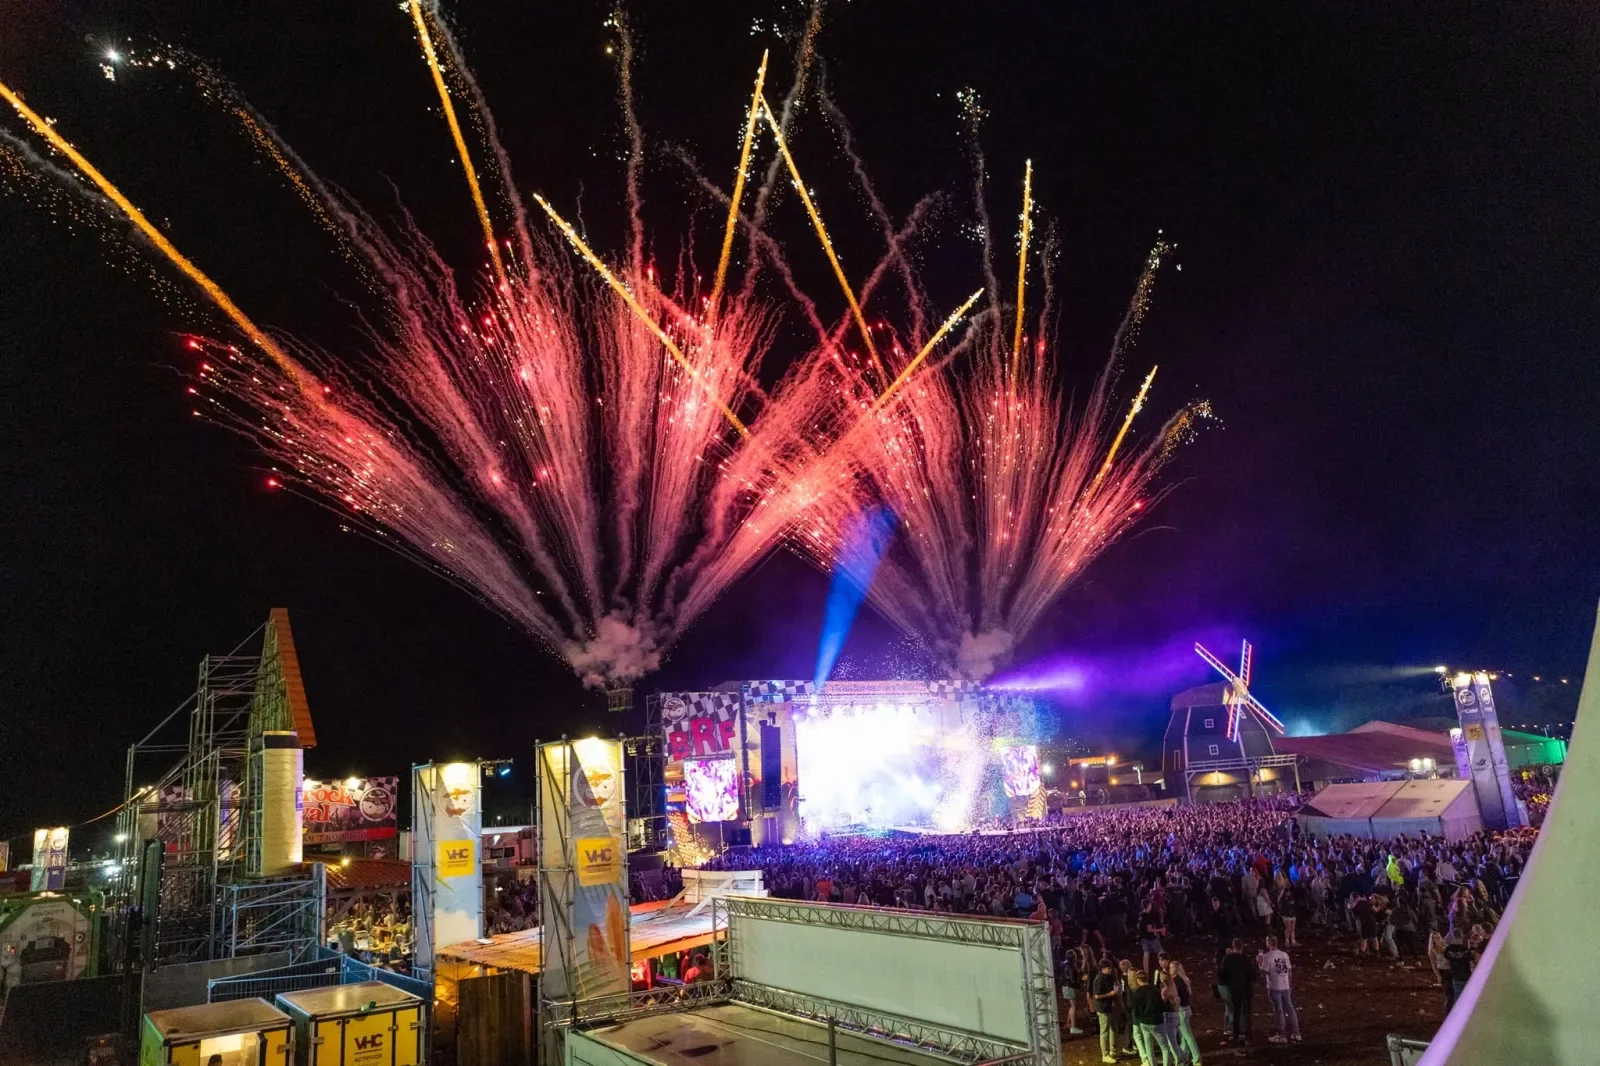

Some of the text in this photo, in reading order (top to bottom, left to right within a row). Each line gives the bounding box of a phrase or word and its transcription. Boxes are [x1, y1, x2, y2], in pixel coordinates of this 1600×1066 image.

[669, 716, 736, 761] BRF
[446, 848, 469, 860] VHC
[584, 848, 612, 862] VHC
[354, 1034, 383, 1050] VHC
